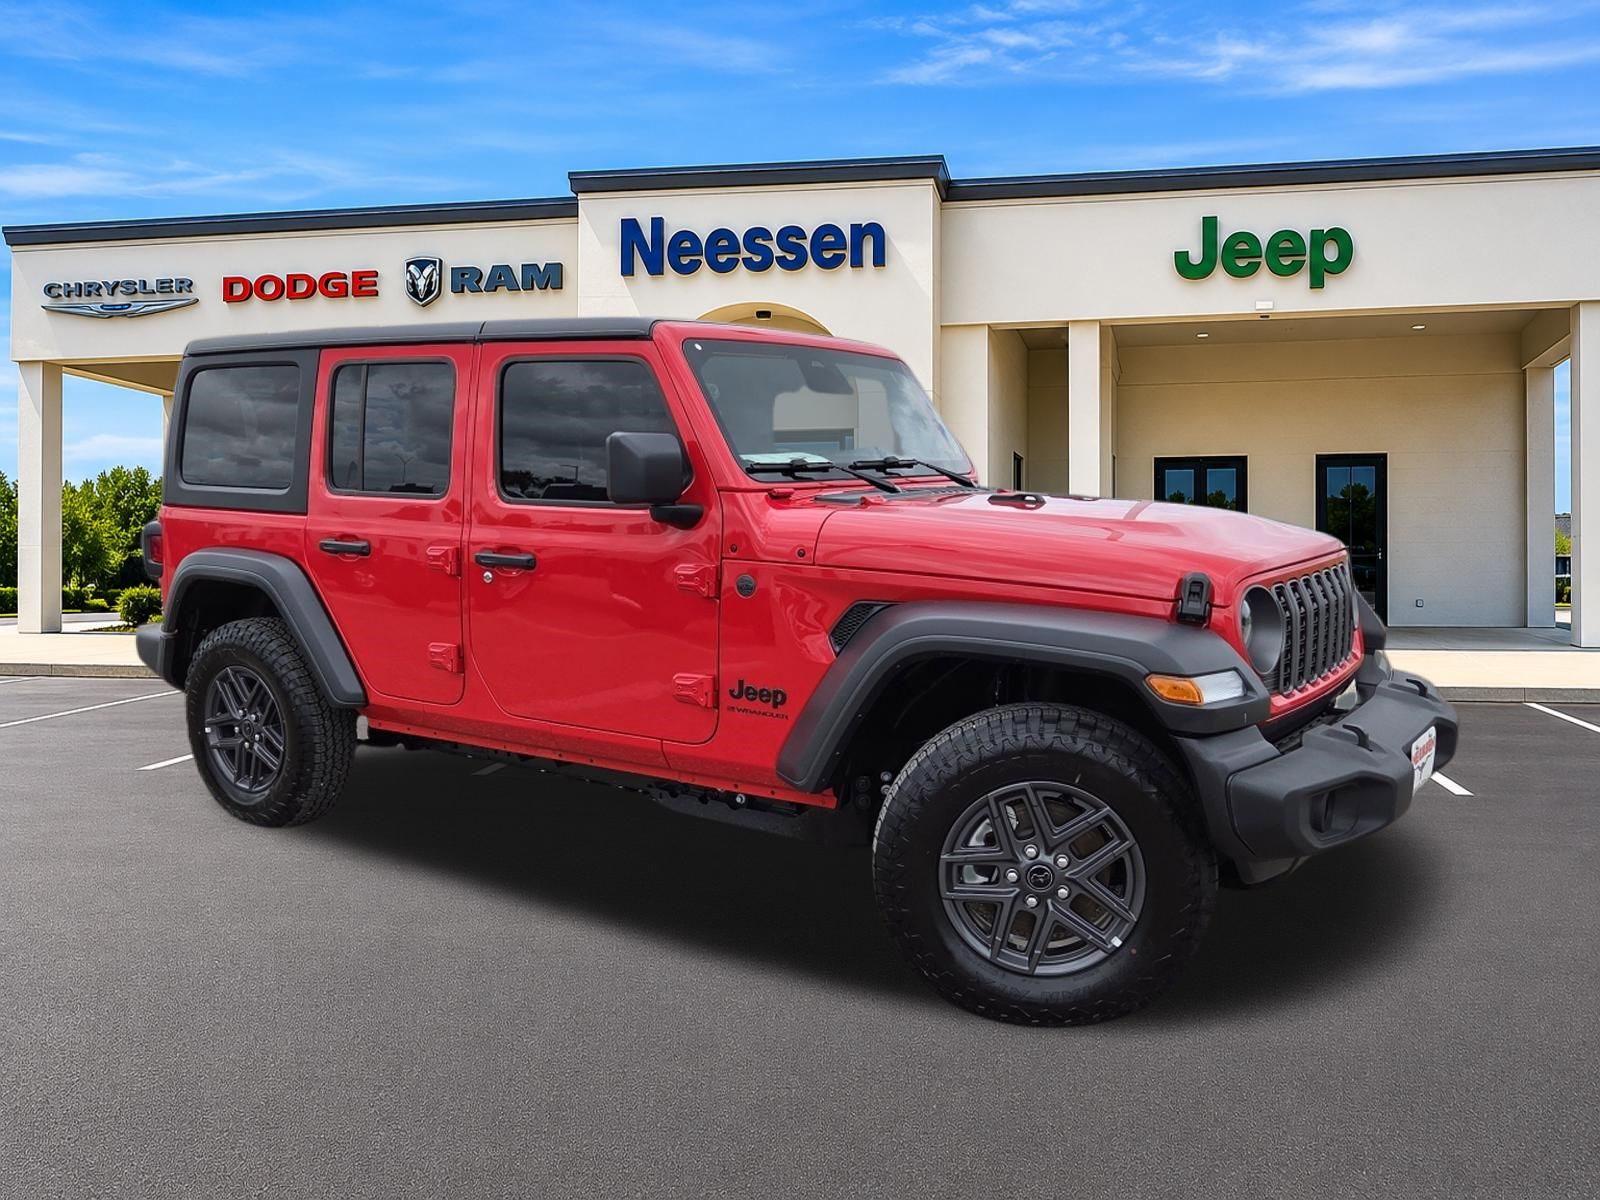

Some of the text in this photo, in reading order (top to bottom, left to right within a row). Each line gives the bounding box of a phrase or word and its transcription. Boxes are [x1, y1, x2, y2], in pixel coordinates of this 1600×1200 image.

[620, 216, 887, 277] Neessen
[1174, 215, 1354, 289] Jeep
[43, 278, 194, 299] CHRYSLER
[222, 271, 379, 303] DODGE
[450, 262, 564, 294] RAM
[728, 679, 788, 709] Jeep
